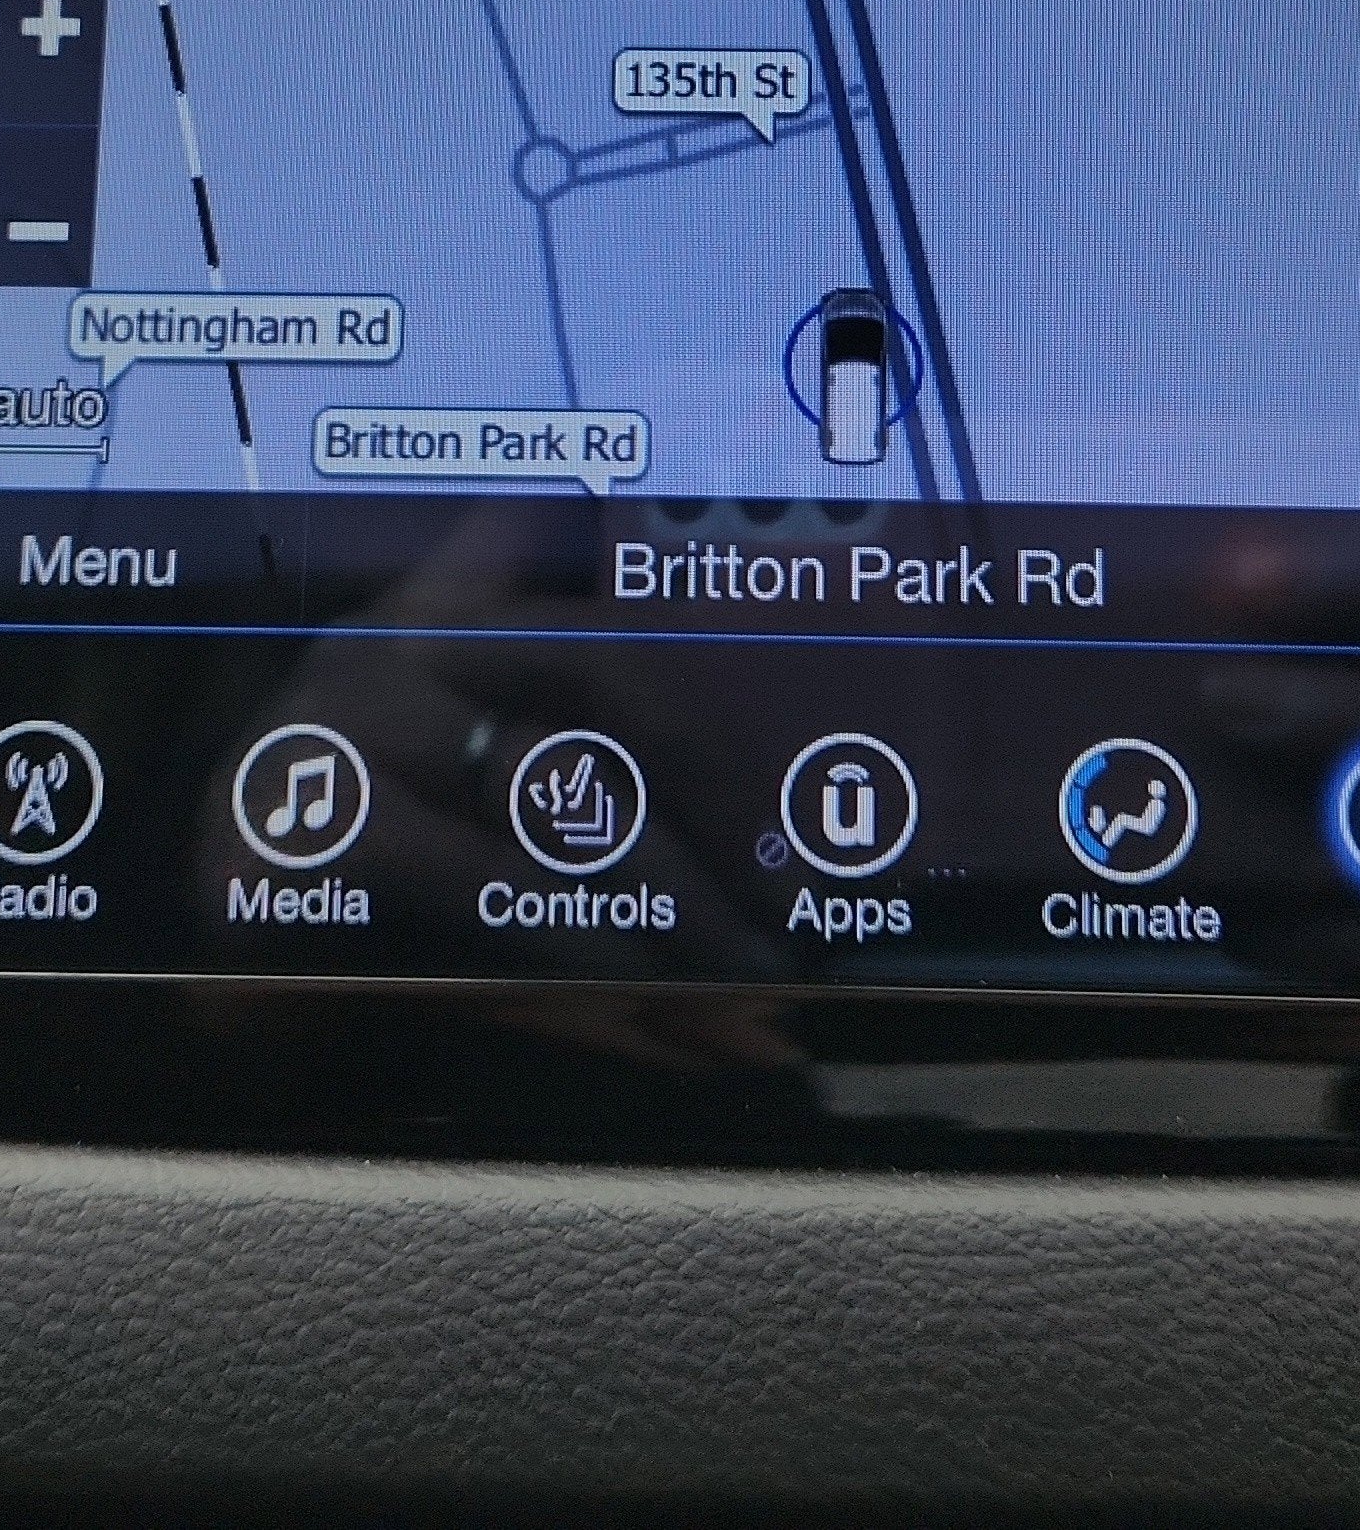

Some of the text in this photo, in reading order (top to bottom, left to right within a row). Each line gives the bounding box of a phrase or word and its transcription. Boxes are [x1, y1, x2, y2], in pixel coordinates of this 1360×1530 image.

[627, 61, 795, 100] 135th St
[81, 306, 390, 353] Nottingham Rd
[325, 421, 636, 462] Britton Park Rd
[20, 534, 177, 587] Menu
[614, 540, 1104, 607] Britton Park Rd
[227, 877, 371, 924] Media
[478, 881, 676, 929] Controls
[786, 887, 912, 943] Apps
[1041, 892, 1221, 940] Climate
